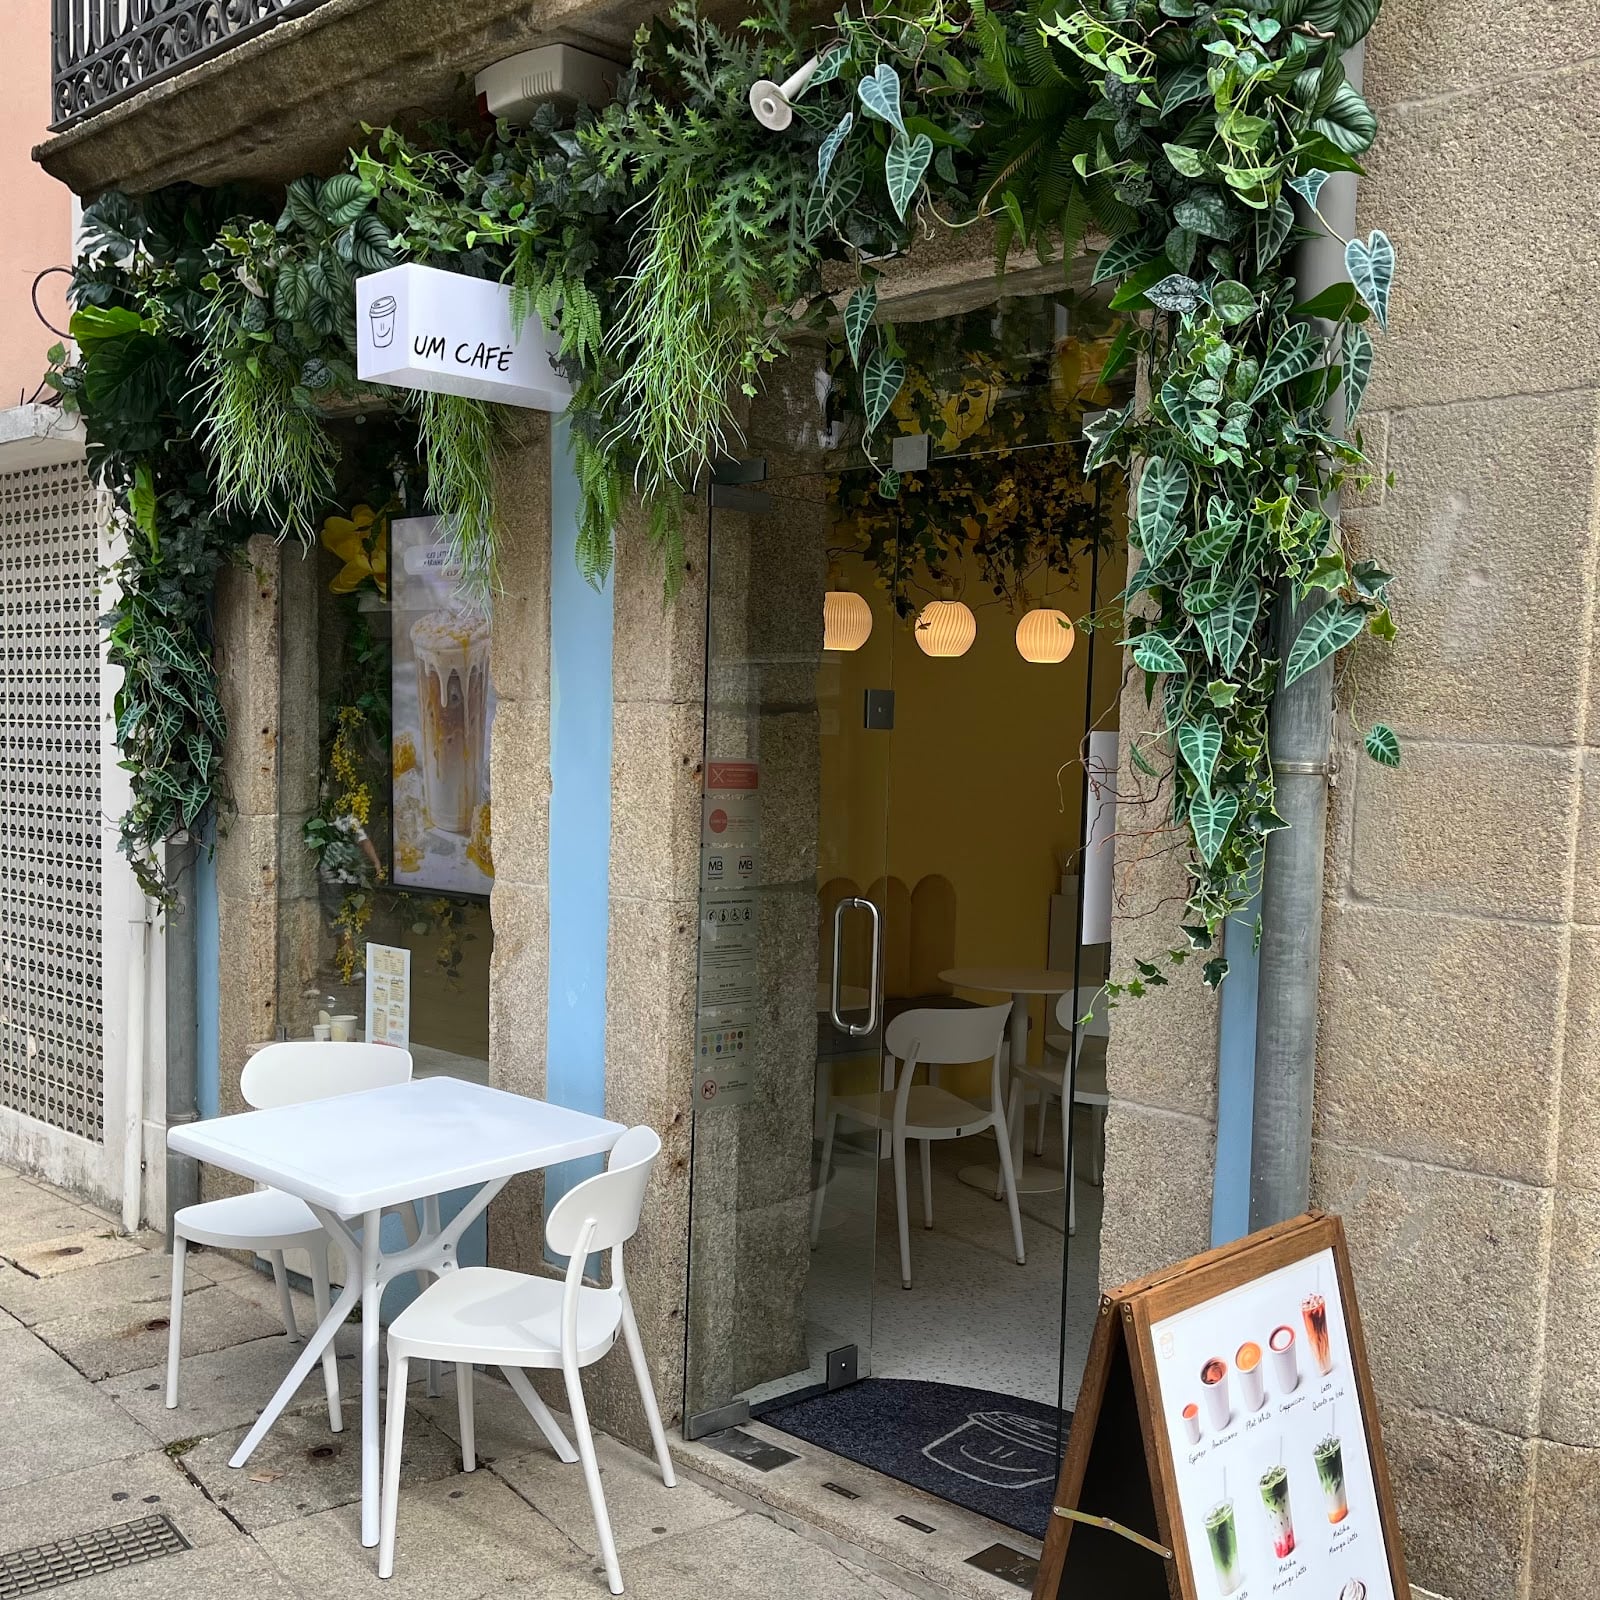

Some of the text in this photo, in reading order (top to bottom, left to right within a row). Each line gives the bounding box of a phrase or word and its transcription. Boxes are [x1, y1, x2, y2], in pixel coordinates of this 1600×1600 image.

[414, 336, 513, 372] UM CAFÉ
[708, 860, 723, 871] MB
[738, 860, 753, 870] MB
[1320, 1382, 1332, 1394] Latte
[1279, 1396, 1306, 1414] Cappuccino
[1257, 1411, 1272, 1425] White
[1211, 1432, 1238, 1449] Americano
[1278, 1559, 1297, 1576] Matcha
[1295, 1564, 1307, 1579] Latte
